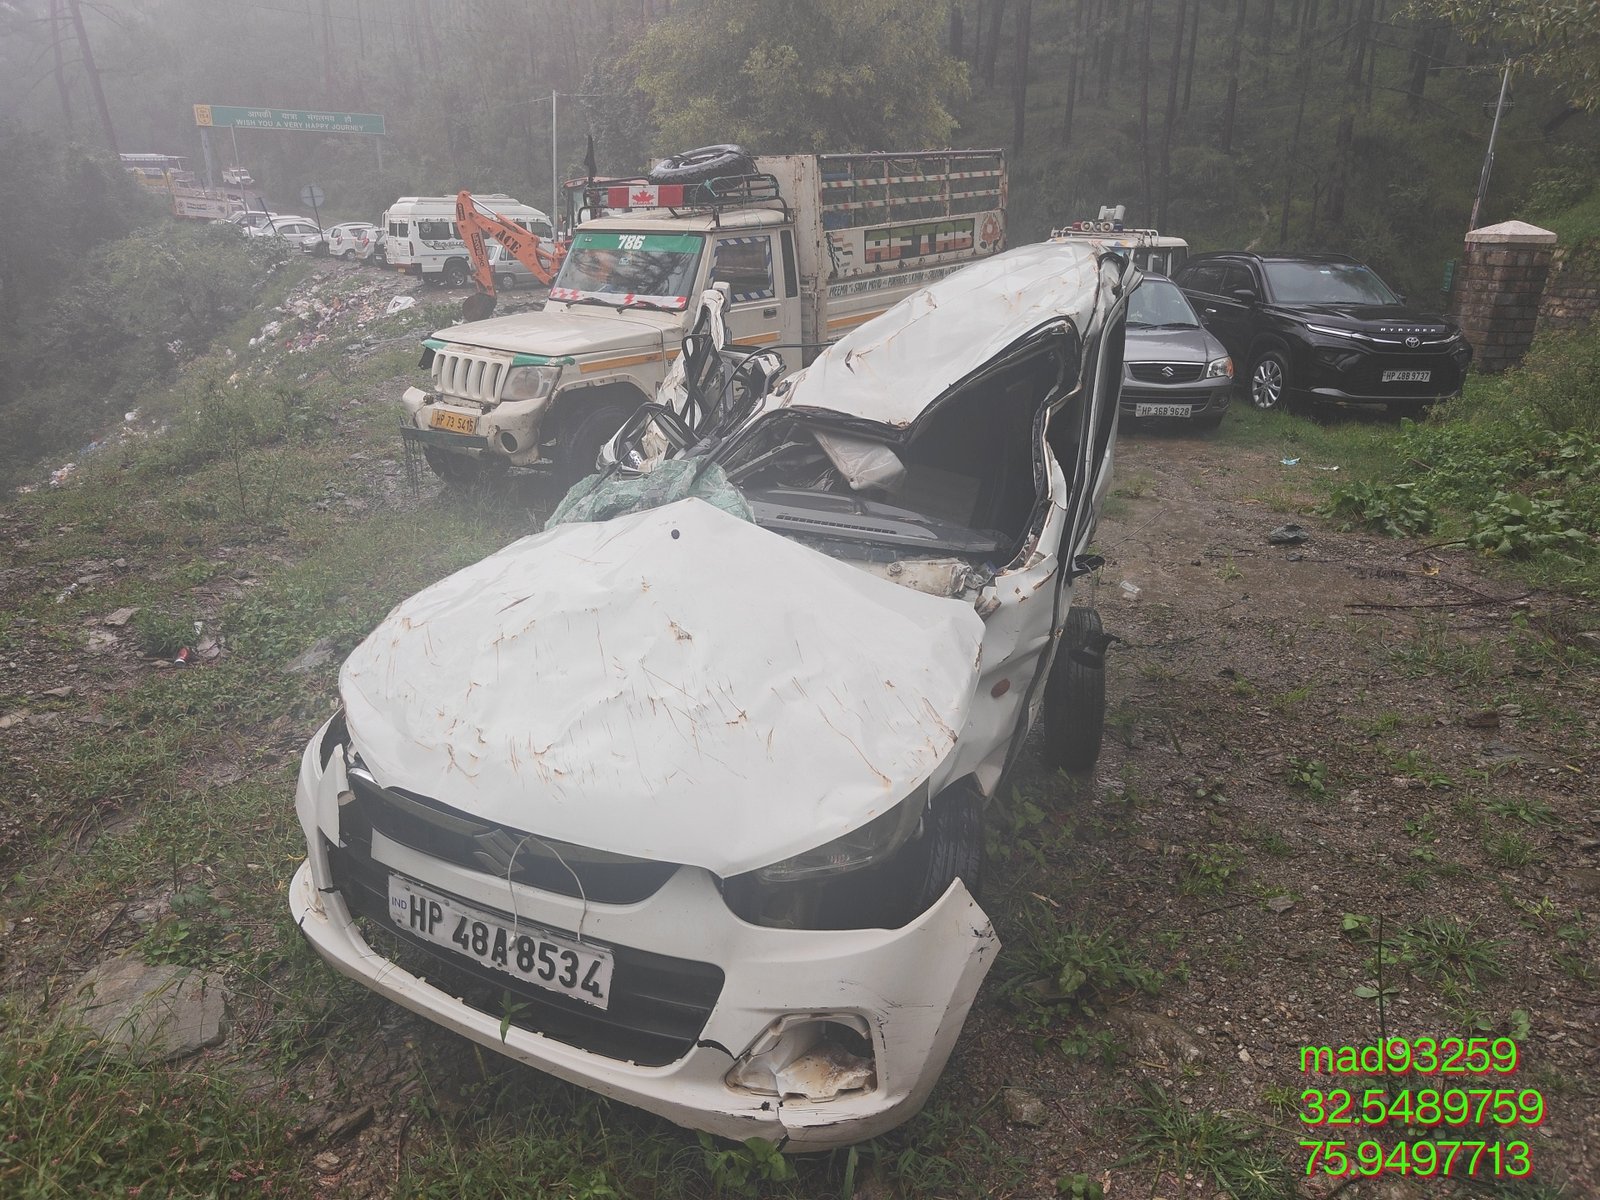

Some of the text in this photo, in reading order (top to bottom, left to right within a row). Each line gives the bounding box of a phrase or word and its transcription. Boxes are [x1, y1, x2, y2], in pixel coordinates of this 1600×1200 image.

[236, 118, 256, 126] WISH
[331, 124, 364, 132] JOURNEY
[495, 229, 522, 254] ACE
[618, 234, 646, 250] 786
[1386, 371, 1396, 380] HP
[1411, 371, 1429, 380] 9737
[1141, 406, 1190, 416] HP 36B 9628
[446, 416, 455, 428] 73
[391, 896, 408, 910] IND
[409, 894, 443, 935] HP
